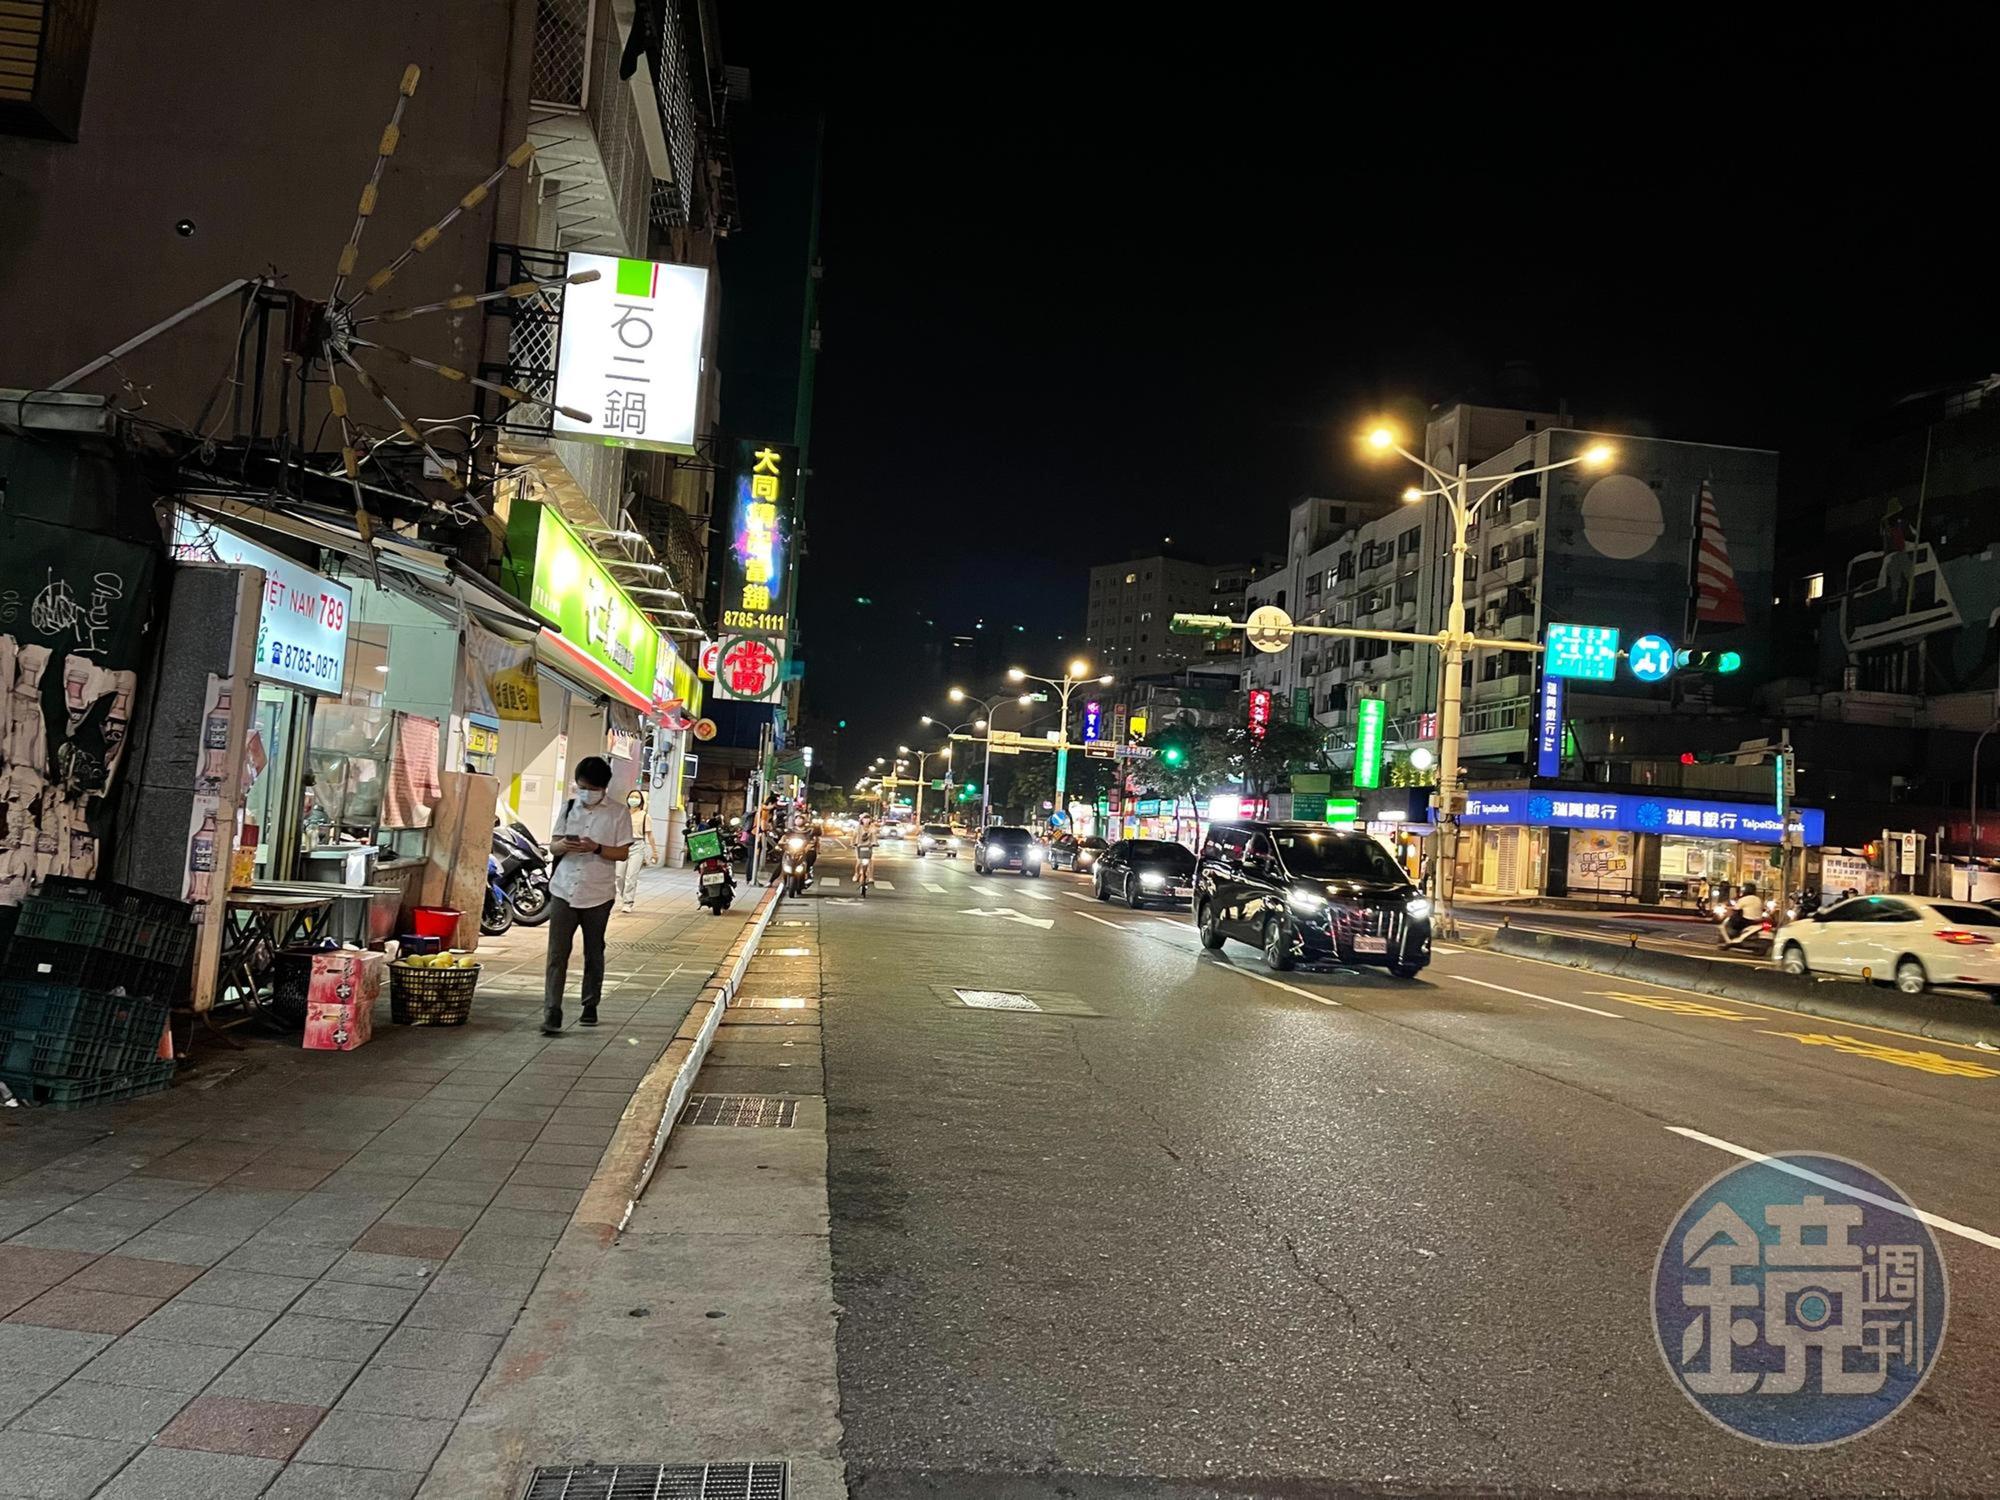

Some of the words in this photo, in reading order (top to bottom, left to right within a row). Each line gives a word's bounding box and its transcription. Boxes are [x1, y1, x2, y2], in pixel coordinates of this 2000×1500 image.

[603, 303, 654, 435] 石二鍋
[289, 588, 316, 619] NAM
[320, 592, 344, 631] 789
[723, 610, 785, 631] 8785-1111
[284, 644, 340, 682] 8785-0871
[724, 640, 776, 695] 當
[1552, 801, 1618, 820] 瑞興銀行
[1666, 808, 1738, 830] 瑞興銀行
